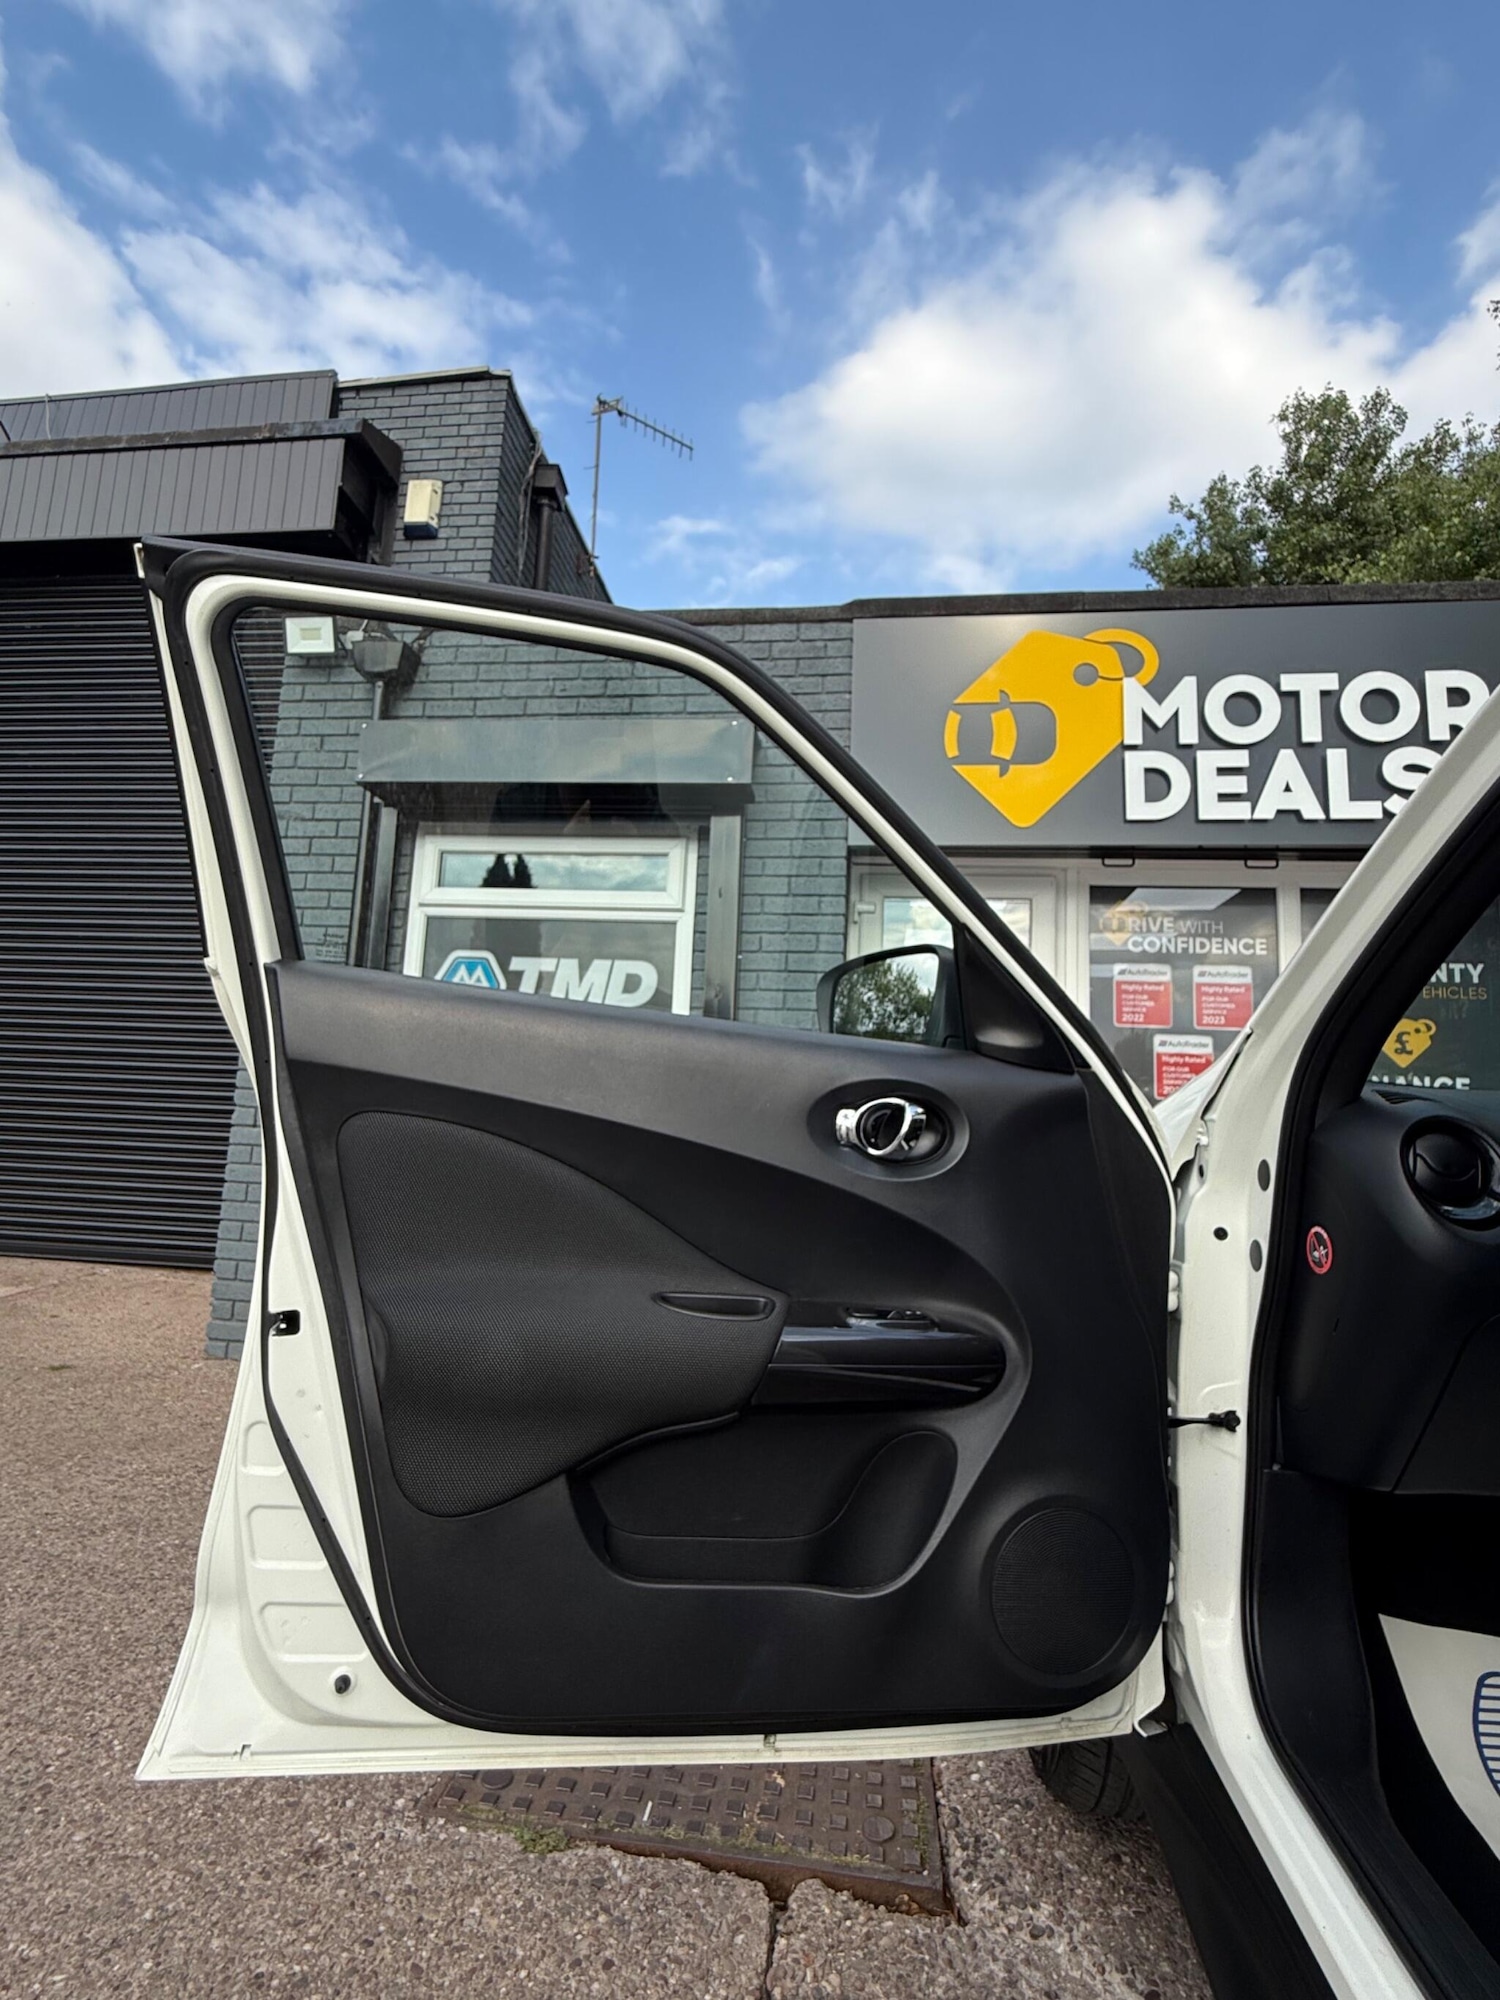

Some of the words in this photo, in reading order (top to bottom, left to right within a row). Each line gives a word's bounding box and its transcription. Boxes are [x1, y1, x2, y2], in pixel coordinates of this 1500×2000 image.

[1122, 670, 1490, 746] MOTOR
[1124, 746, 1443, 821] DEALS
[1180, 919, 1224, 934] WITH
[1127, 935, 1268, 955] CONFIDENCE
[508, 956, 658, 1008] TMD
[1122, 1013, 1145, 1022] 2022
[1202, 1015, 1225, 1025] 2023
